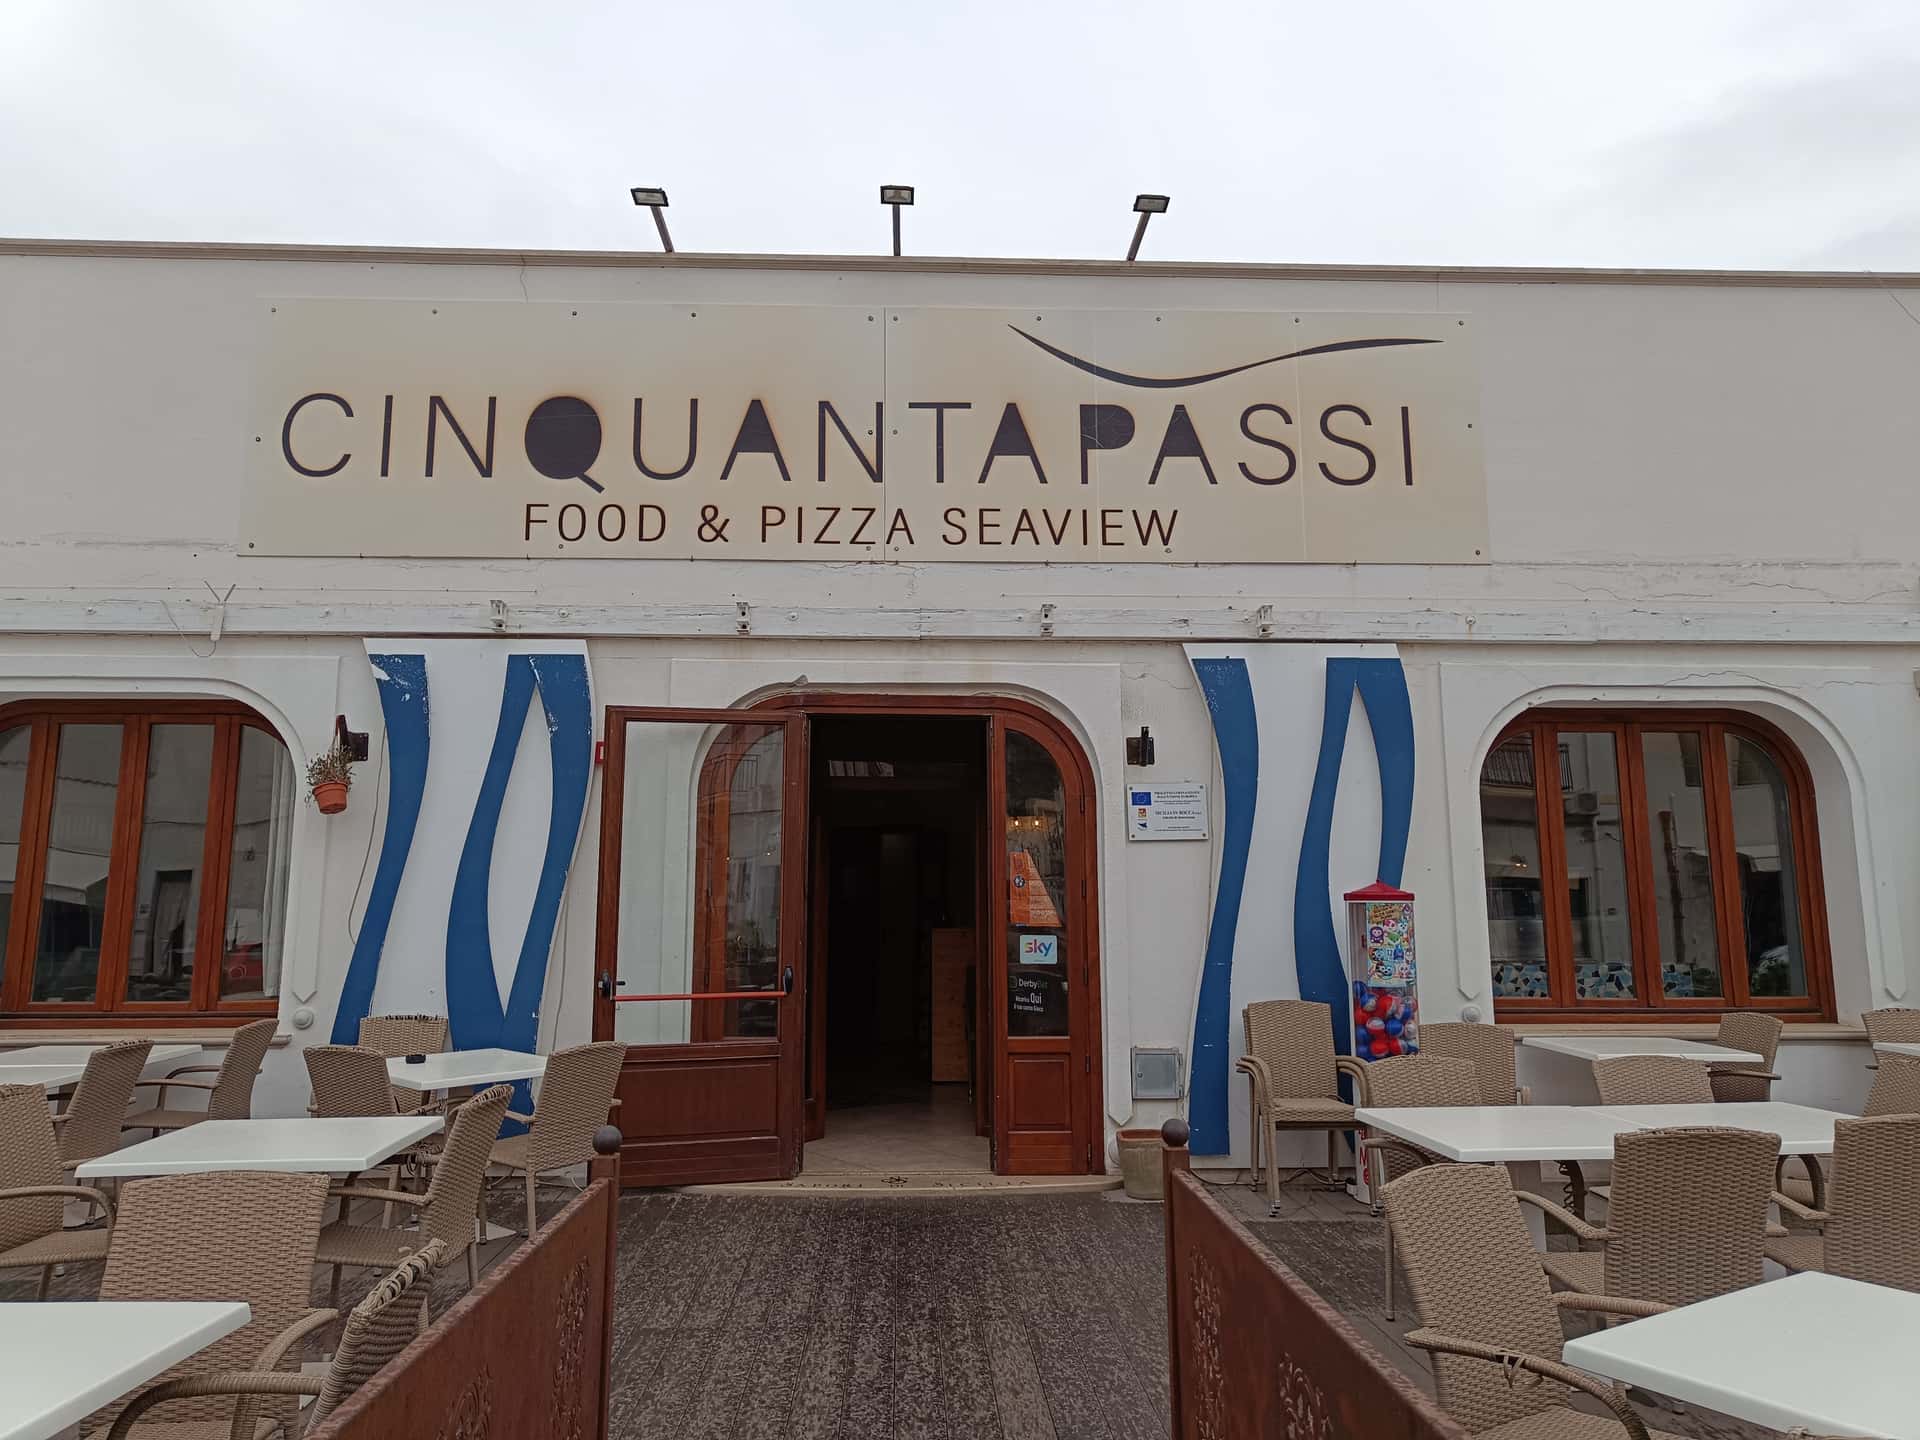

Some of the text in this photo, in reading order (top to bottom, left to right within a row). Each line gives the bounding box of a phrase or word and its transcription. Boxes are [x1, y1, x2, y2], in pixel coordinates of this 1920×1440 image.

[281, 392, 1414, 494] CINQUANTAPASSI
[523, 503, 1179, 547] FOOD & PIZZA SEAVIEW
[1024, 939, 1053, 957] sky
